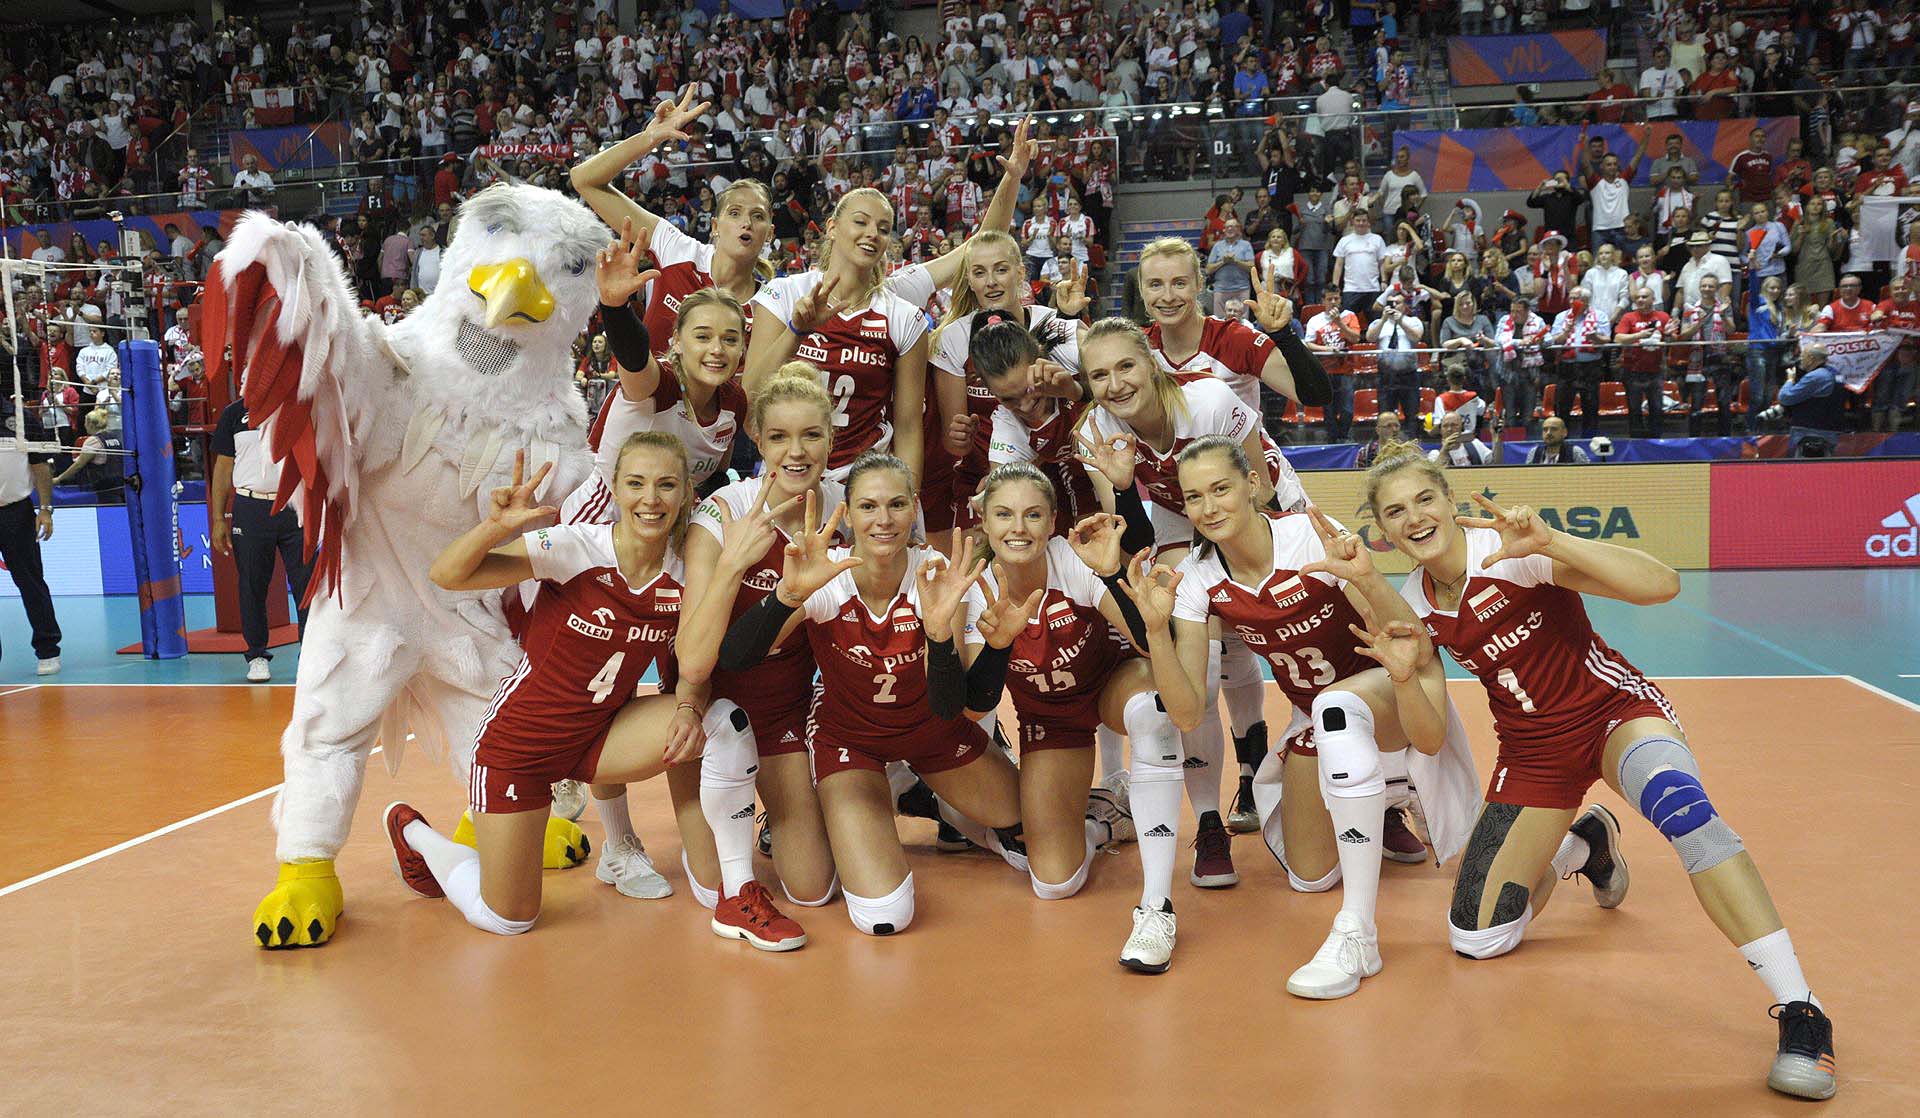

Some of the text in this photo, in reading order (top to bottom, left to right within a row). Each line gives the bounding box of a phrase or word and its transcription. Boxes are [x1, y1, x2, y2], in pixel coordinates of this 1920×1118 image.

[494, 144, 554, 155] POLSKA
[1214, 140, 1233, 155] D1
[341, 181, 354, 192] E2
[36, 205, 49, 217] F2
[368, 195, 382, 209] F1
[860, 331, 887, 340] POLSKA
[799, 345, 826, 362] RLEN
[840, 346, 878, 366] plus
[1828, 341, 1879, 354] POLSKA
[991, 438, 1005, 451] lus
[693, 456, 717, 476] plu
[1865, 526, 1920, 557] ad
[745, 576, 775, 589] RLEN
[1277, 590, 1309, 609] POLSKA
[1477, 598, 1511, 623] POLSKA
[570, 617, 610, 639] ORLEN
[894, 623, 921, 633] POLSKA
[1049, 614, 1078, 631] POLSKA
[1275, 614, 1322, 641] plus
[626, 624, 670, 643] plus
[1242, 632, 1264, 645] LEN
[1482, 623, 1532, 662] plus
[883, 646, 925, 674] plus
[1051, 637, 1085, 670] plus
[1269, 646, 1337, 689] 23
[586, 651, 626, 704] 4
[1025, 669, 1077, 694] 15
[872, 673, 898, 704] 2
[1497, 667, 1538, 713] 1
[838, 747, 850, 763] 2
[1495, 767, 1509, 793] 1
[505, 783, 518, 801] 4
[731, 811, 755, 820] adid
[1144, 830, 1175, 838] adidas
[1338, 833, 1371, 844] adidas
